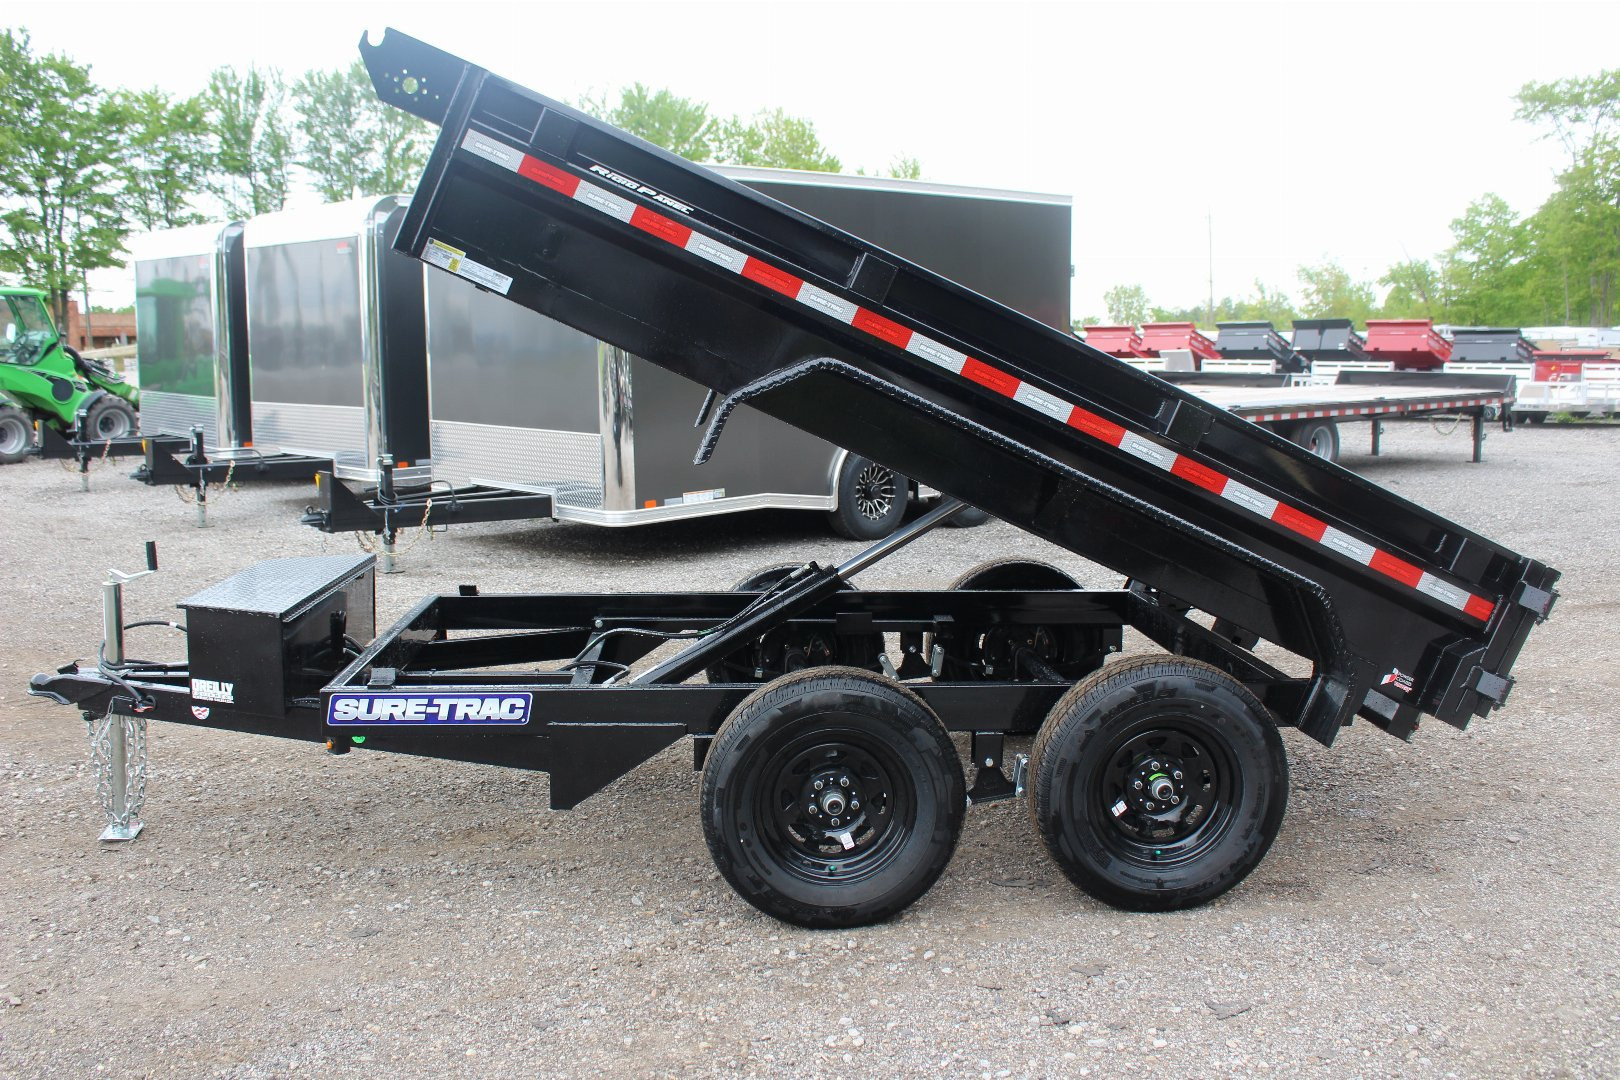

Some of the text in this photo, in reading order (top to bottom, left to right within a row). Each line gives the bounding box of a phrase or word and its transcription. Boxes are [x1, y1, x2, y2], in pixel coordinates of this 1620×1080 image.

[589, 164, 640, 190] RIGID
[636, 185, 694, 214] PANEL
[333, 697, 526, 721] SURE-TRAC
